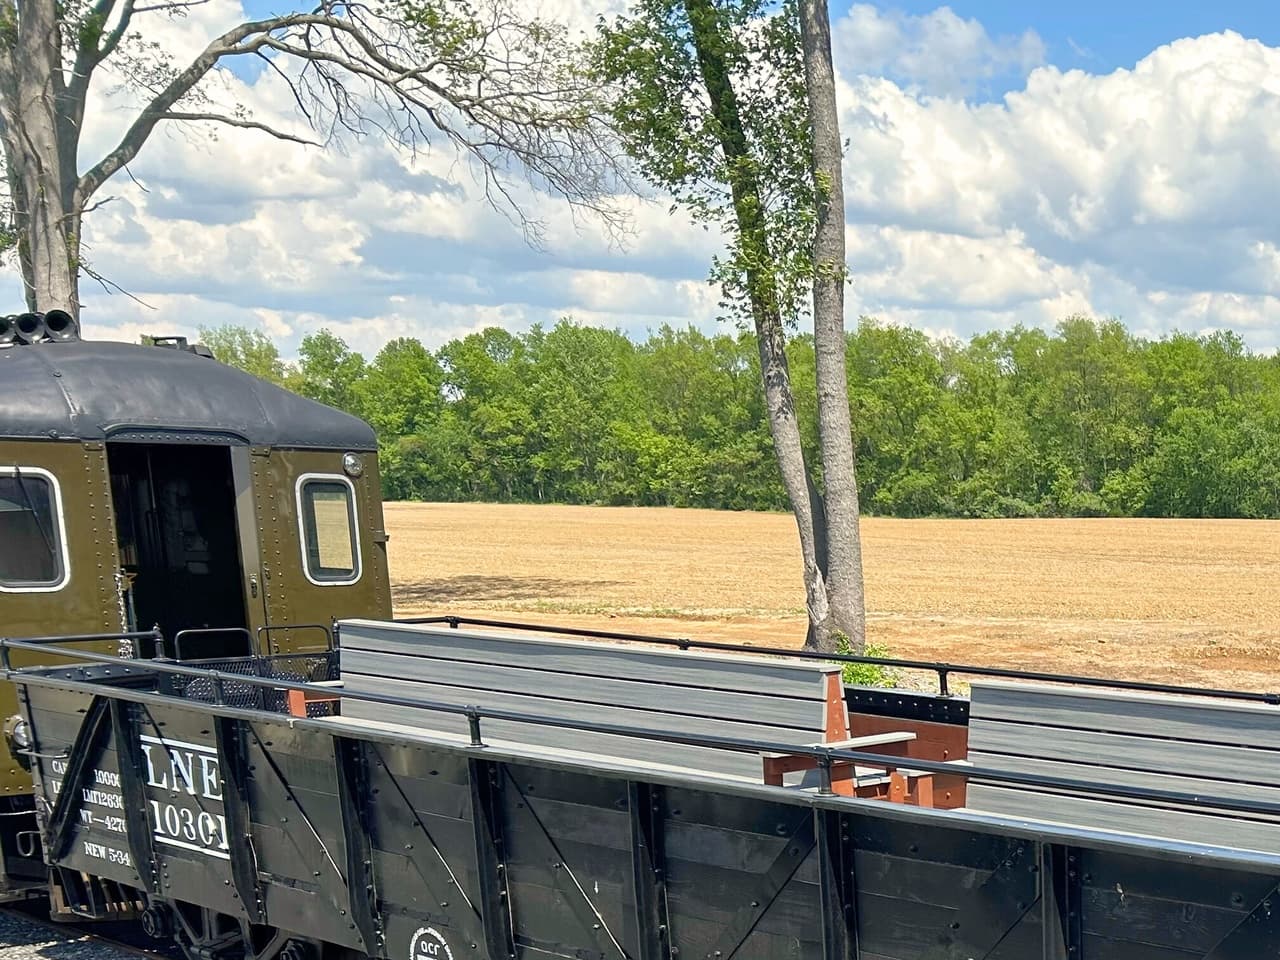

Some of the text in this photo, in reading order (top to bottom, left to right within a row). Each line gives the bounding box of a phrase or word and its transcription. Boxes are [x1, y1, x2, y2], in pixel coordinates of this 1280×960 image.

[141, 744, 223, 801] LNE
[84, 841, 131, 867] NEW 5-34
